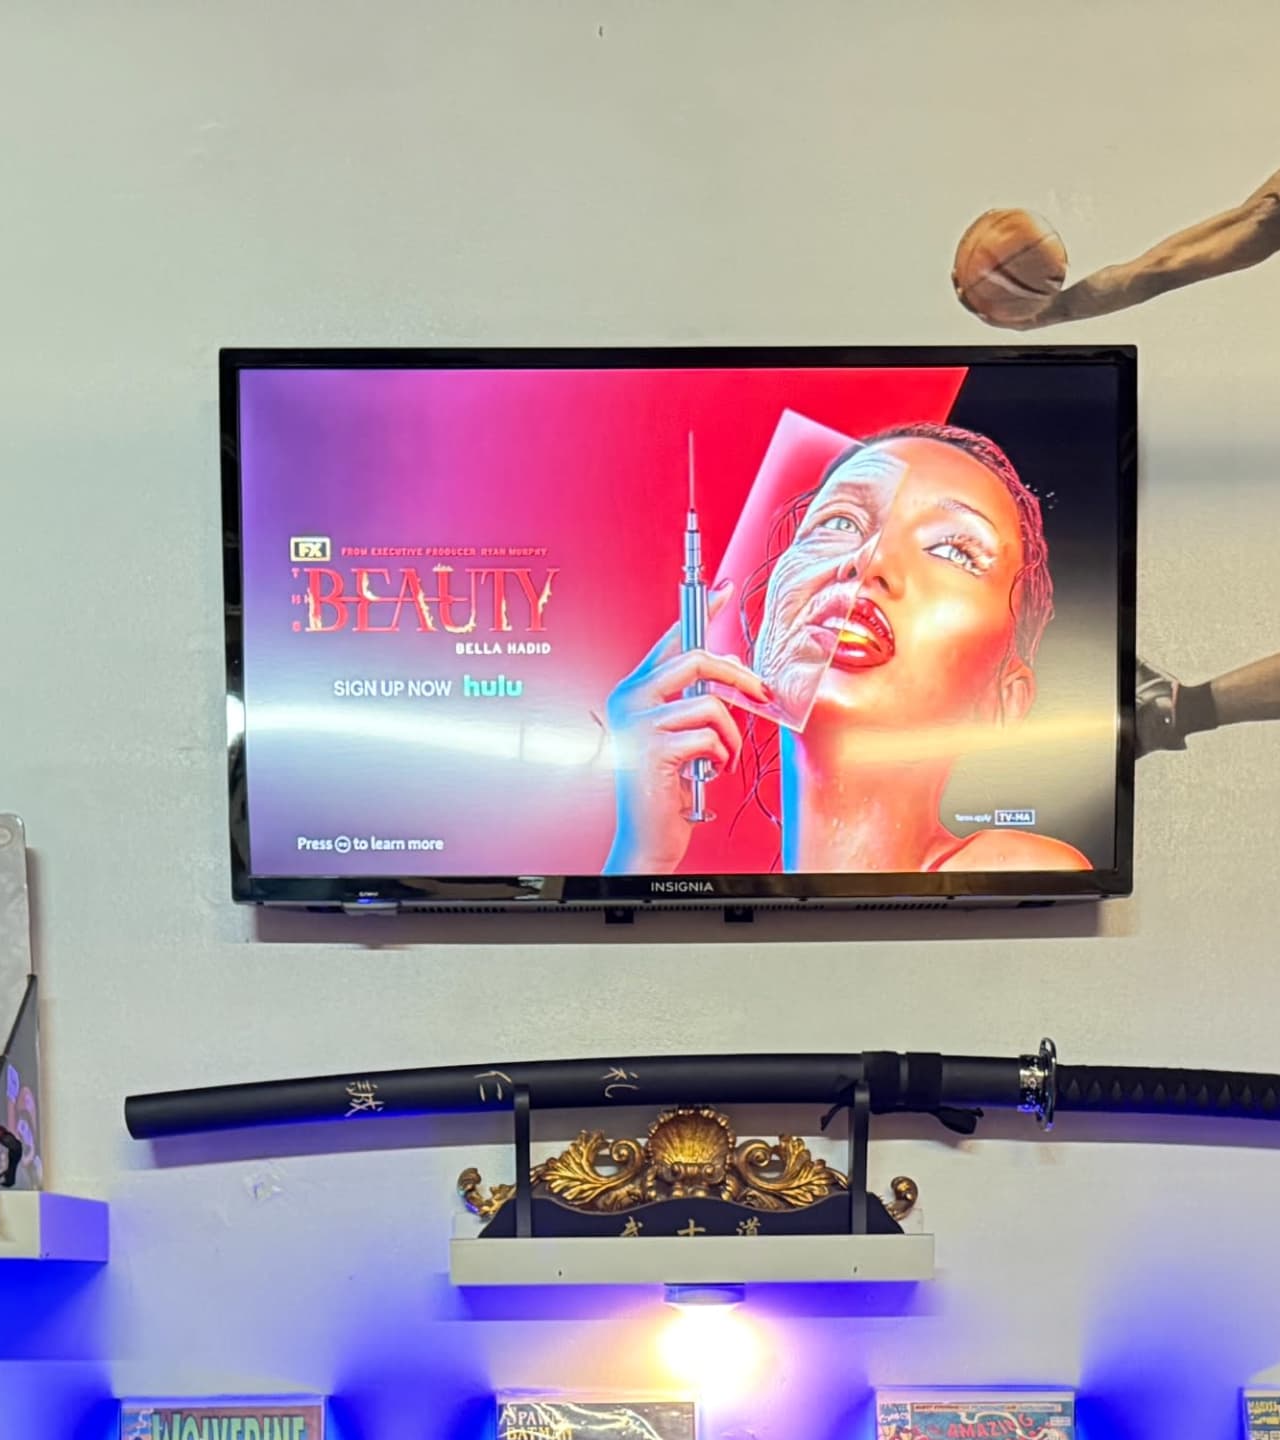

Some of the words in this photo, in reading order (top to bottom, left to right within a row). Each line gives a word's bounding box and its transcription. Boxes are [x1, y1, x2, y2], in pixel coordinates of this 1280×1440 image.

[341, 547, 368, 556] FROM
[371, 547, 423, 556] EXECUTIVE
[426, 547, 476, 556] PRODUCER
[480, 547, 506, 556] RYAN
[304, 565, 560, 633] BEAUTY
[456, 643, 503, 655] BELLA
[507, 643, 551, 655] HADID
[333, 680, 377, 697] SIGN
[381, 680, 405, 697] UP
[408, 680, 452, 697] NOW
[463, 675, 524, 697] hulu
[999, 813, 1031, 822] TV-MA
[297, 837, 333, 851] Press
[353, 838, 369, 851] to
[371, 836, 406, 850] learn
[408, 839, 444, 851] more
[651, 882, 714, 892] INSIGNIA
